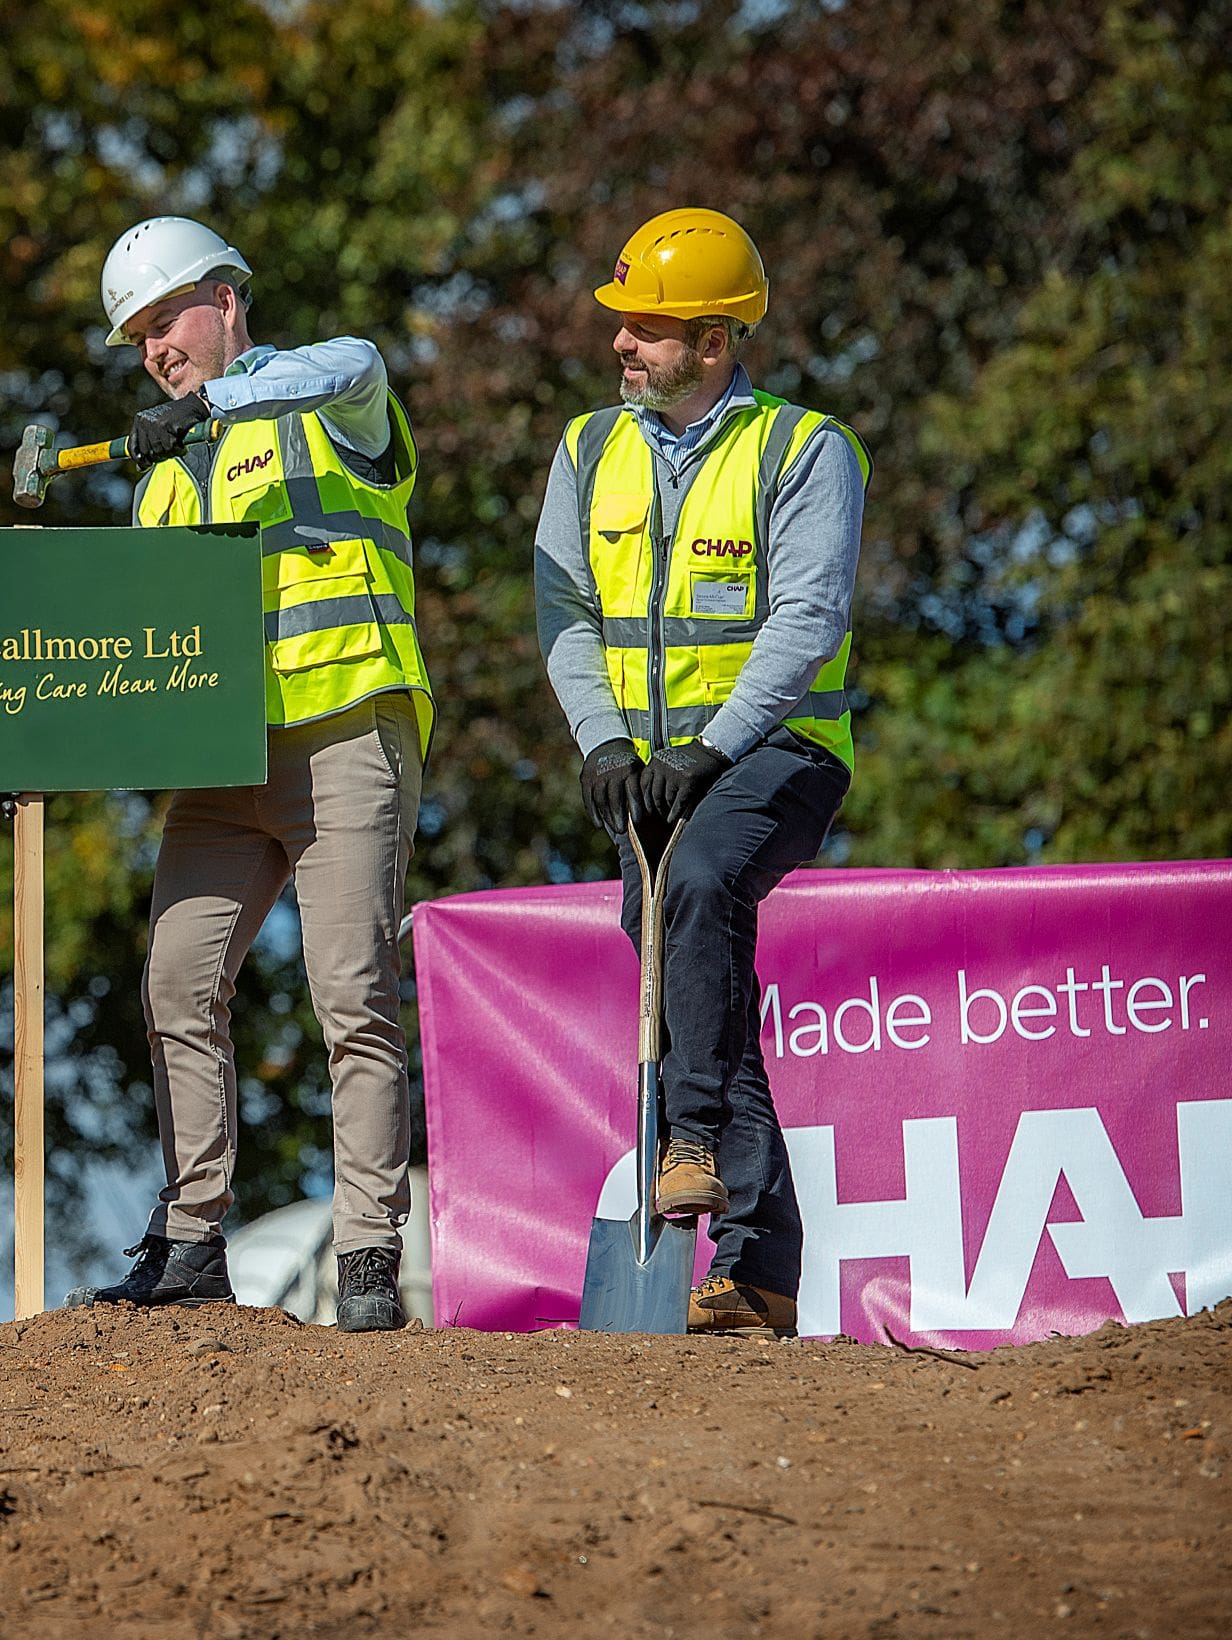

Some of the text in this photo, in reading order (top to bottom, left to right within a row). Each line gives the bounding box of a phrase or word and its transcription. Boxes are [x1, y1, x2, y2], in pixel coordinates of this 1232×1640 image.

[227, 449, 274, 482] CHAP
[691, 538, 753, 558] CHAP
[143, 625, 203, 658] Ltd
[35, 672, 88, 700] Care
[97, 663, 158, 697] Mean
[165, 658, 220, 692] More
[957, 964, 1210, 1047] better.
